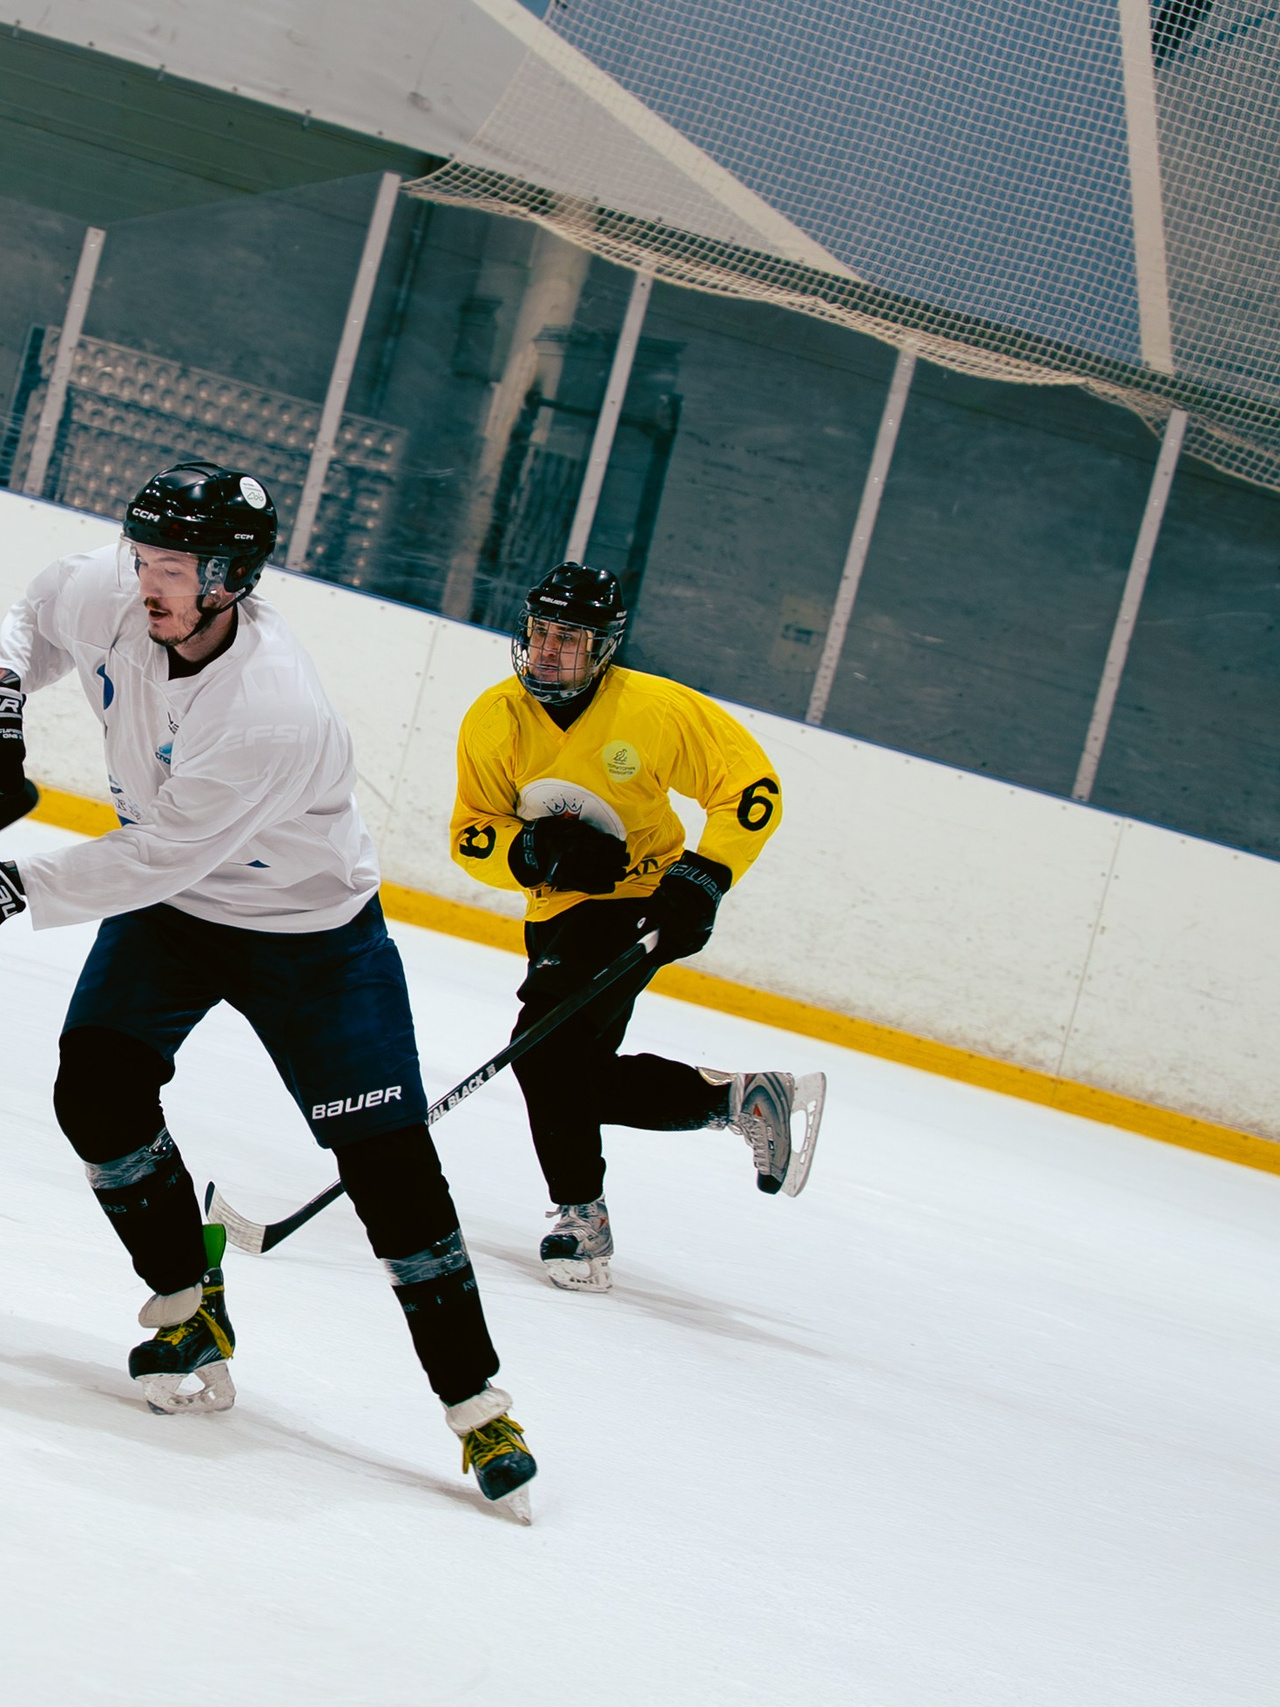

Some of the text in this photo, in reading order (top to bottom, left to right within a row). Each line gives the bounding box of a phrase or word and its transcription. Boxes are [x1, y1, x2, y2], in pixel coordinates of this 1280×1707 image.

[132, 507, 161, 522] CCM
[234, 533, 254, 541] CCM
[737, 777, 779, 832] 6
[312, 1086, 402, 1120] BAUER
[447, 1072, 485, 1107] BLACK
